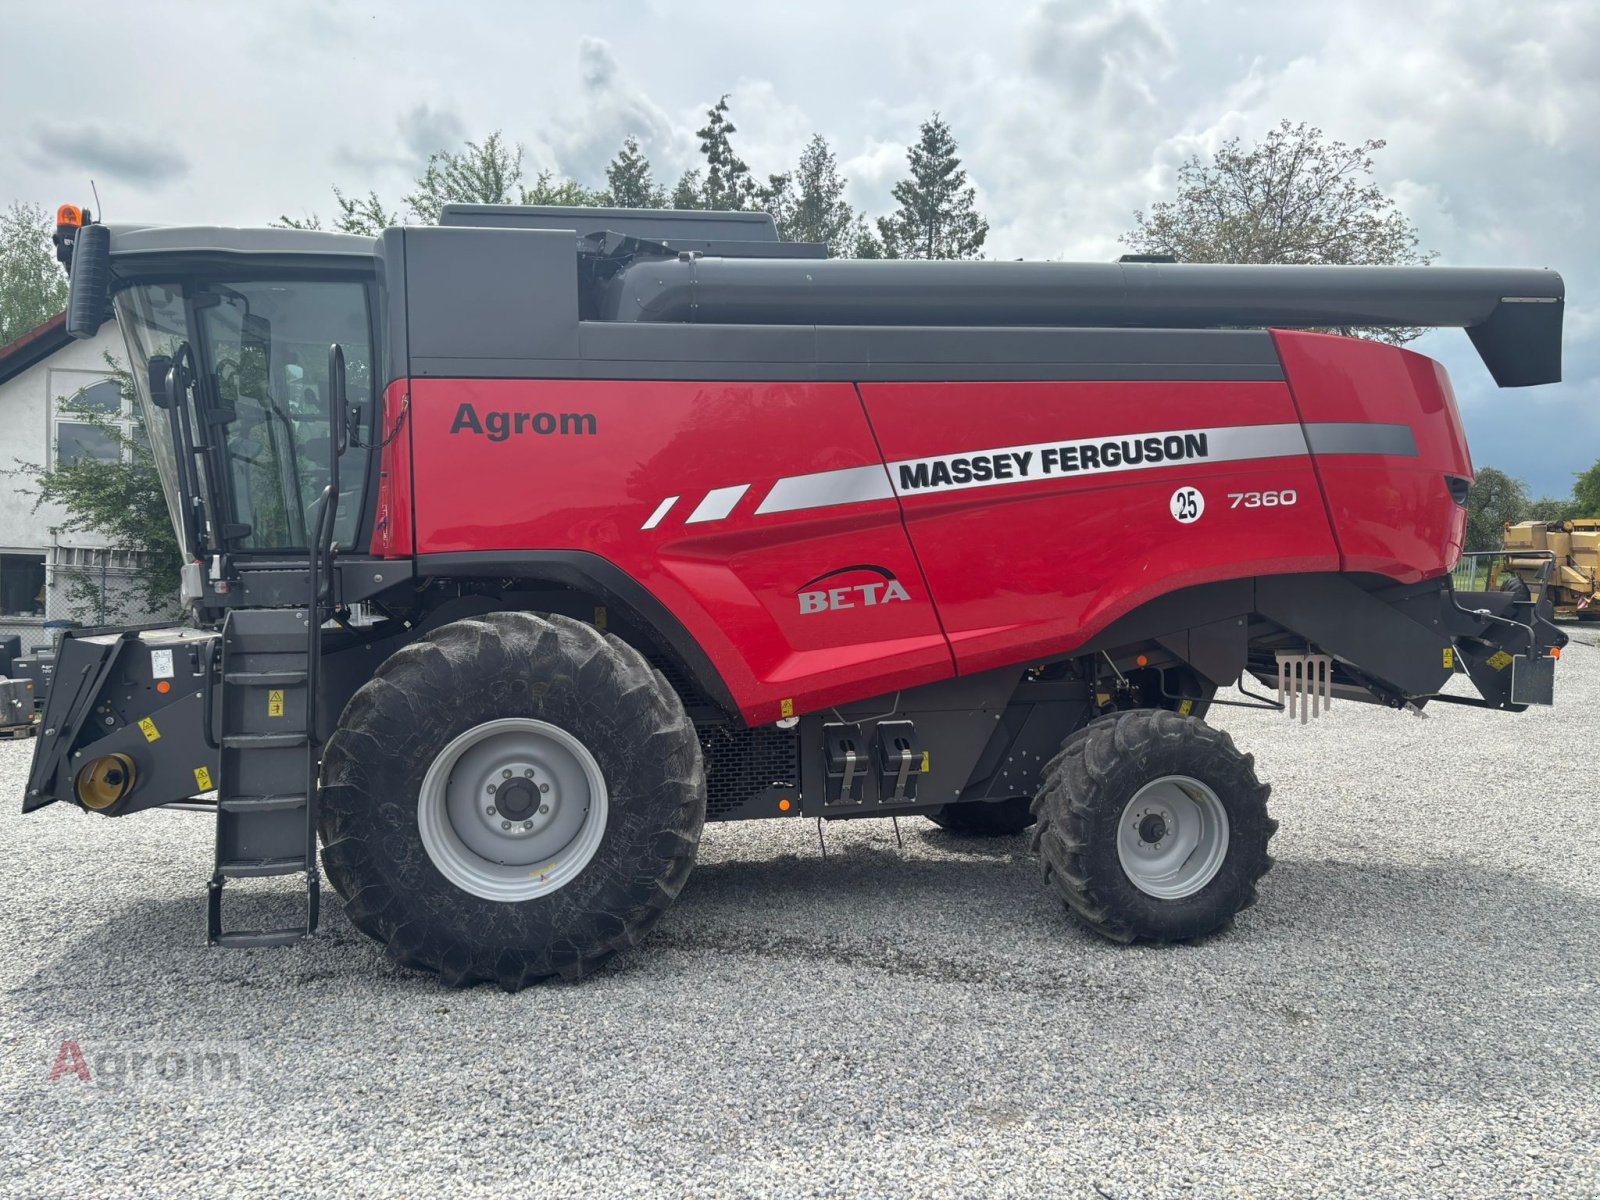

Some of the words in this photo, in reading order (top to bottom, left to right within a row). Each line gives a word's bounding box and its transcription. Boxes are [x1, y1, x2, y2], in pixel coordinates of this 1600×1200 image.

[450, 403, 597, 442] Agrom
[900, 451, 1032, 490] MASSEY
[1041, 432, 1208, 475] FERGUSON
[1176, 490, 1198, 520] 25
[1227, 489, 1297, 510] 7360
[798, 580, 912, 614] BETA
